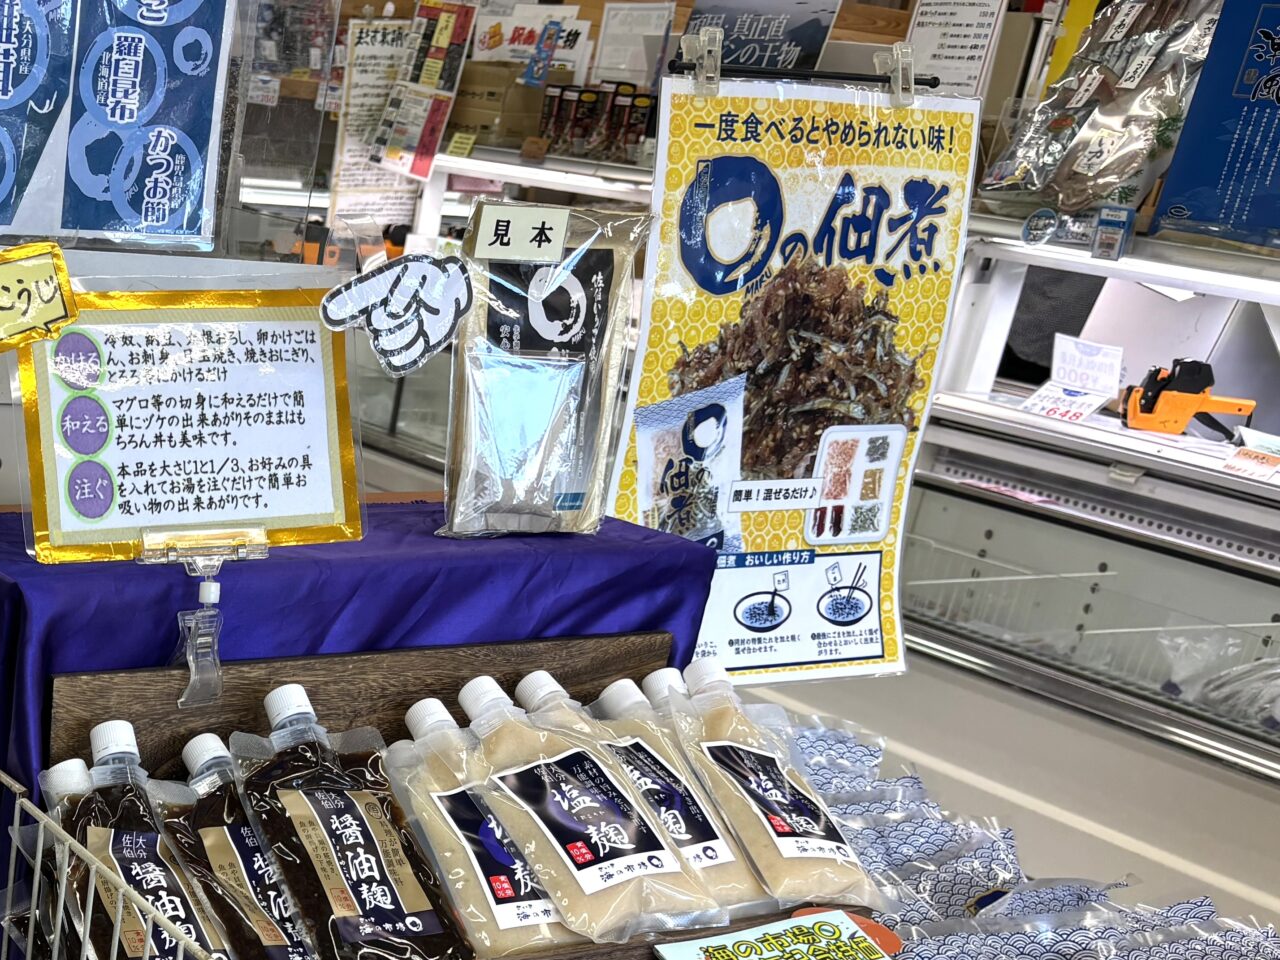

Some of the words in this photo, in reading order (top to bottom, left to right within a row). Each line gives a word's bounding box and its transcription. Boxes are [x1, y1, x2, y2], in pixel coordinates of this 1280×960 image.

[97, 51, 112, 106] 北海道産
[107, 32, 146, 124] 羅臼昆布
[141, 127, 177, 226] かつお節
[744, 267, 773, 299] MARU
[112, 390, 305, 413] マグロ等の切身に和えるだけで簡
[62, 412, 109, 435] 和える
[115, 431, 238, 451] ちろん丼も美味です。
[74, 478, 108, 501] 注ぐ
[117, 473, 308, 498] を入れてお湯を注ぐだけで簡単お
[118, 492, 269, 516] 吸い物の出来あがりです。
[745, 552, 811, 565] おいしい作り方
[330, 792, 345, 809] 大分
[550, 782, 637, 858] 塩麹
[122, 834, 135, 859] 佐伯
[135, 837, 148, 859] 大分
[241, 826, 258, 848] 佐伯
[330, 813, 395, 911] 醤油麹
